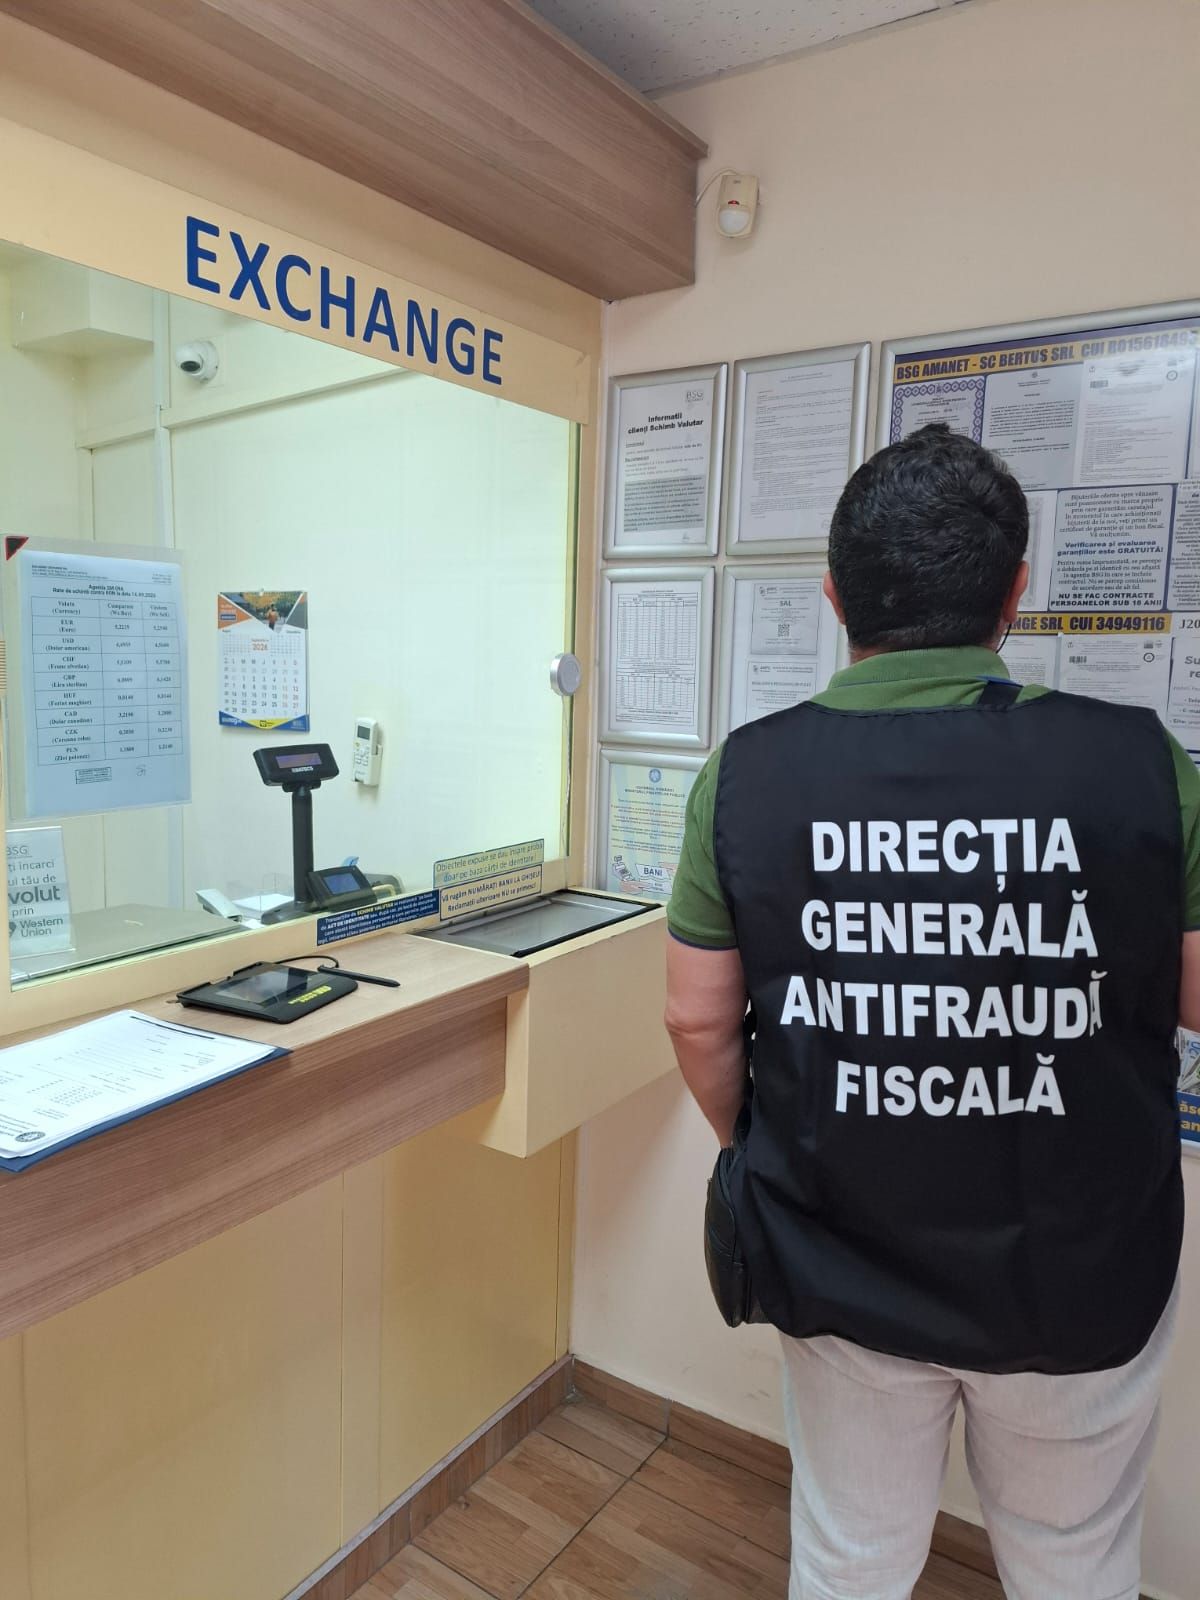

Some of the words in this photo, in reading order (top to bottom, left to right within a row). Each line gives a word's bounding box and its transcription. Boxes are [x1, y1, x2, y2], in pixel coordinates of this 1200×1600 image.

[187, 216, 503, 385] EXCHANGE
[897, 363, 920, 380] BSG
[922, 358, 970, 377] AMANET
[980, 354, 997, 370] SC
[999, 348, 1048, 367] BERTUS
[1051, 346, 1075, 362] SRL
[1081, 341, 1105, 357] CUI
[678, 420, 704, 428] Valutar
[1040, 616, 1064, 630] SRL
[1069, 616, 1093, 630] CUI
[1096, 616, 1165, 630] 34949116
[811, 818, 1081, 893] DIRECȚIA
[436, 860, 467, 872] Obiectele
[644, 868, 663, 877] BANI
[22, 875, 40, 885] tău
[42, 874, 56, 883] de
[450, 891, 467, 902] rugăm
[12, 906, 34, 918] prin
[20, 918, 63, 929] Western
[802, 889, 1098, 958] GENERALĂ
[21, 928, 52, 938] Union
[780, 970, 1108, 1040] ANTIFRAUDĂ
[835, 1053, 1066, 1116] FISCALĂ
